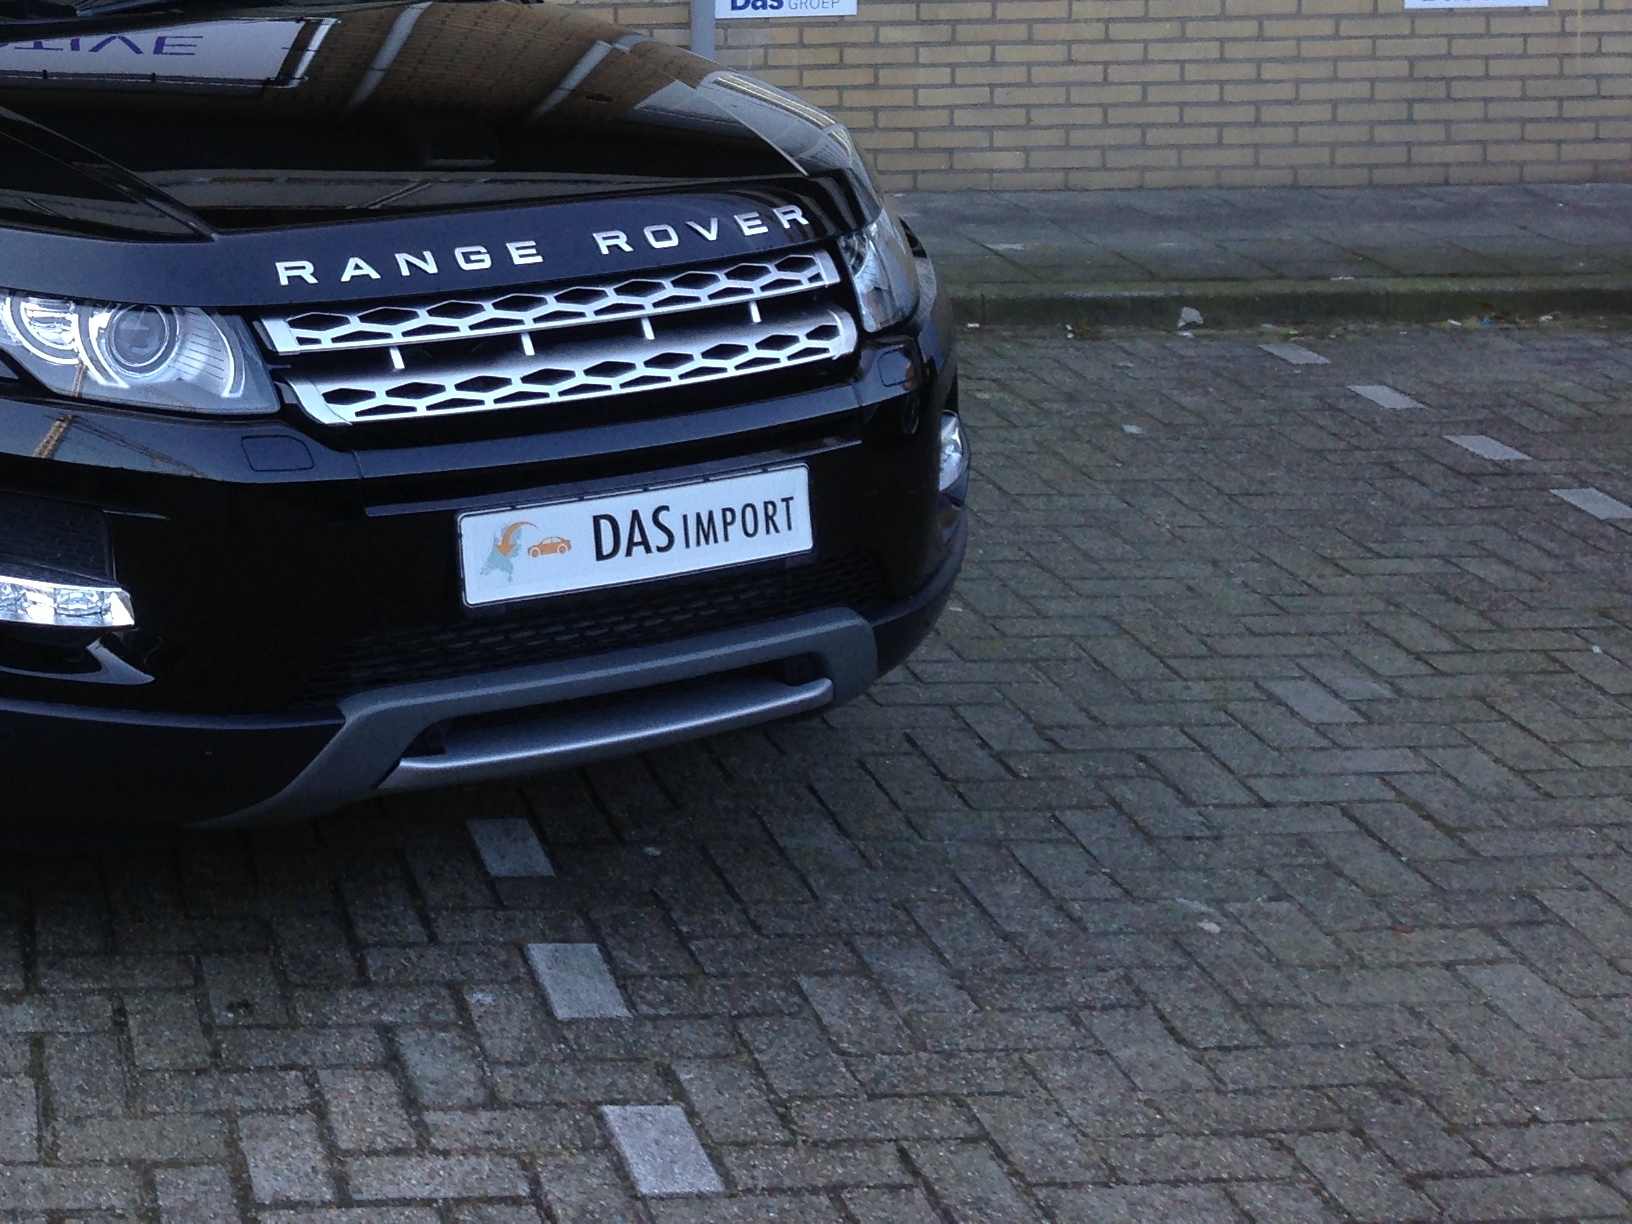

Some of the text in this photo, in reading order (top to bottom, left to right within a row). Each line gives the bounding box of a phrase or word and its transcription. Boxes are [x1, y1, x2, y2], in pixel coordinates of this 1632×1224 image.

[275, 203, 811, 287] RANGE ROVER
[592, 496, 796, 563] DAS IMPORT
